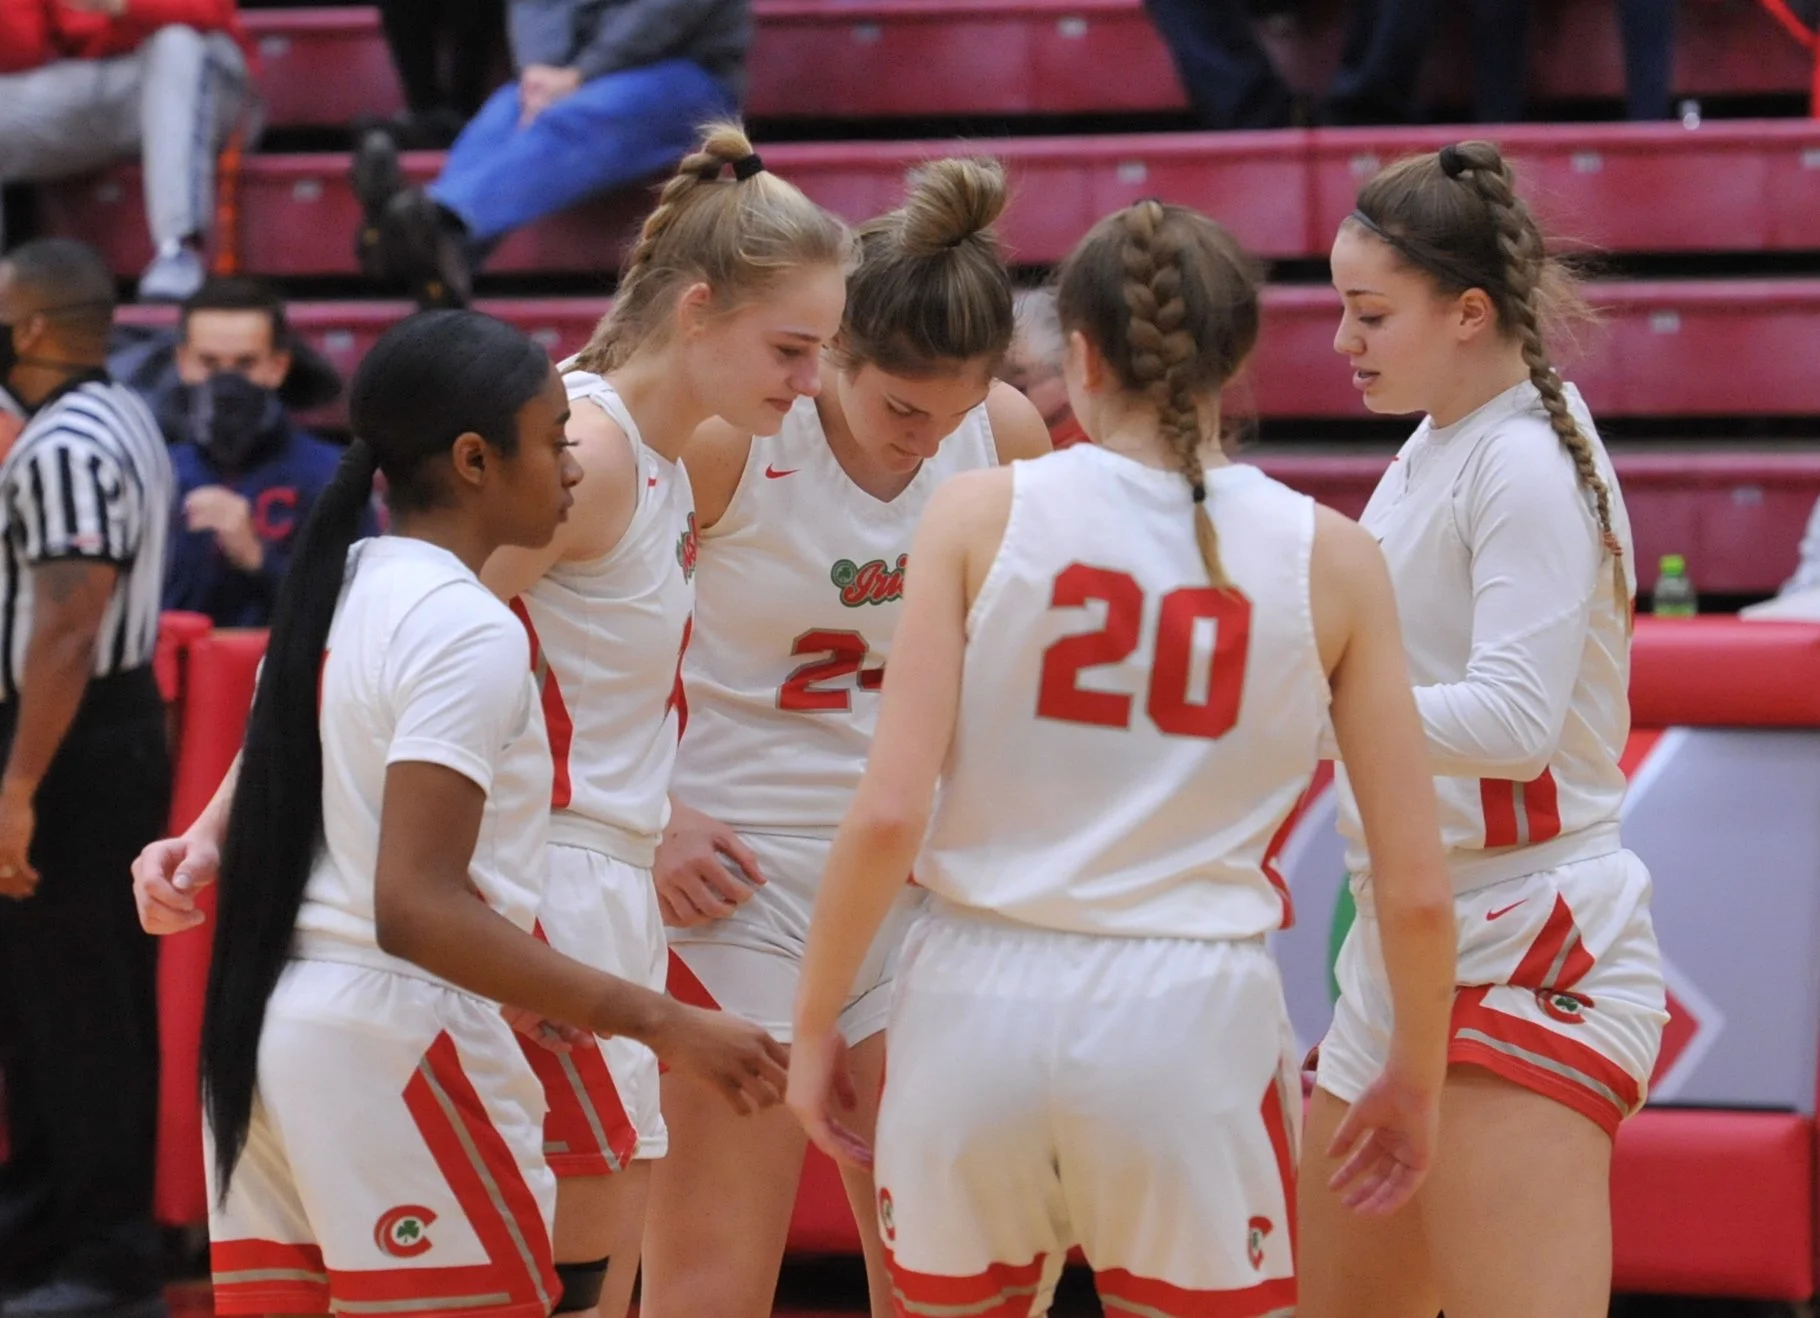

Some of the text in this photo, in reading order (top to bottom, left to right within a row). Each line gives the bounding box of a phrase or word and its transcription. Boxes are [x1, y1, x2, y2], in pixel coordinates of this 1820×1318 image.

[255, 486, 298, 540] C
[840, 553, 908, 607] Iri
[1035, 560, 1255, 740] 20
[374, 1204, 438, 1259] C
